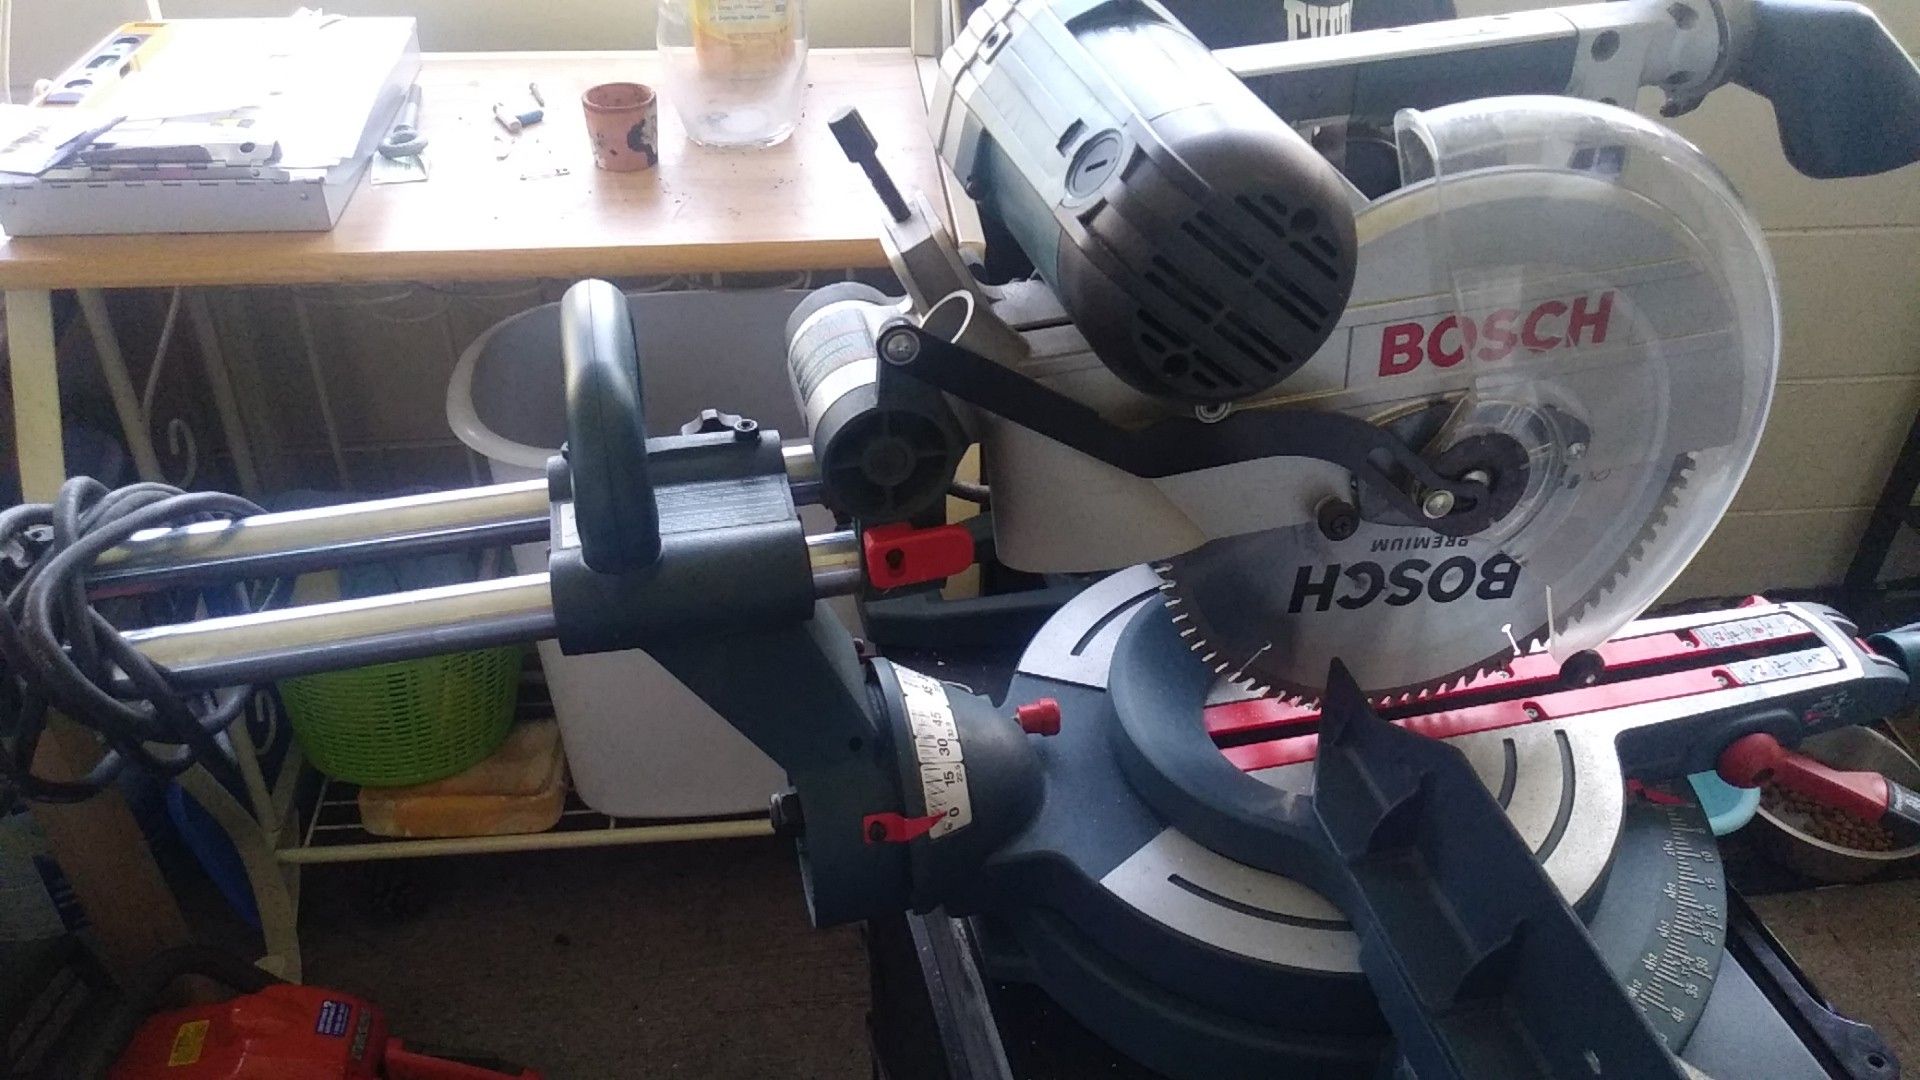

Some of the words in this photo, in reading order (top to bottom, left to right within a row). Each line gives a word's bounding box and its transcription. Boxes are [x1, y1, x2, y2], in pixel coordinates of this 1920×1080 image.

[1379, 291, 1614, 377] BOSCH
[1371, 536, 1468, 552] PREMIUM
[1288, 550, 1521, 613] BOSCH
[931, 711, 942, 726] 45
[937, 738, 950, 756] 30
[943, 770, 955, 787] 15
[949, 806, 960, 818] 0
[1701, 850, 1713, 863] 10
[1704, 877, 1717, 890] 15
[1705, 903, 1719, 918] 20
[1702, 929, 1716, 946] 25
[1696, 956, 1709, 973] 30
[1684, 982, 1699, 999] 35
[1671, 1006, 1686, 1023] 40
